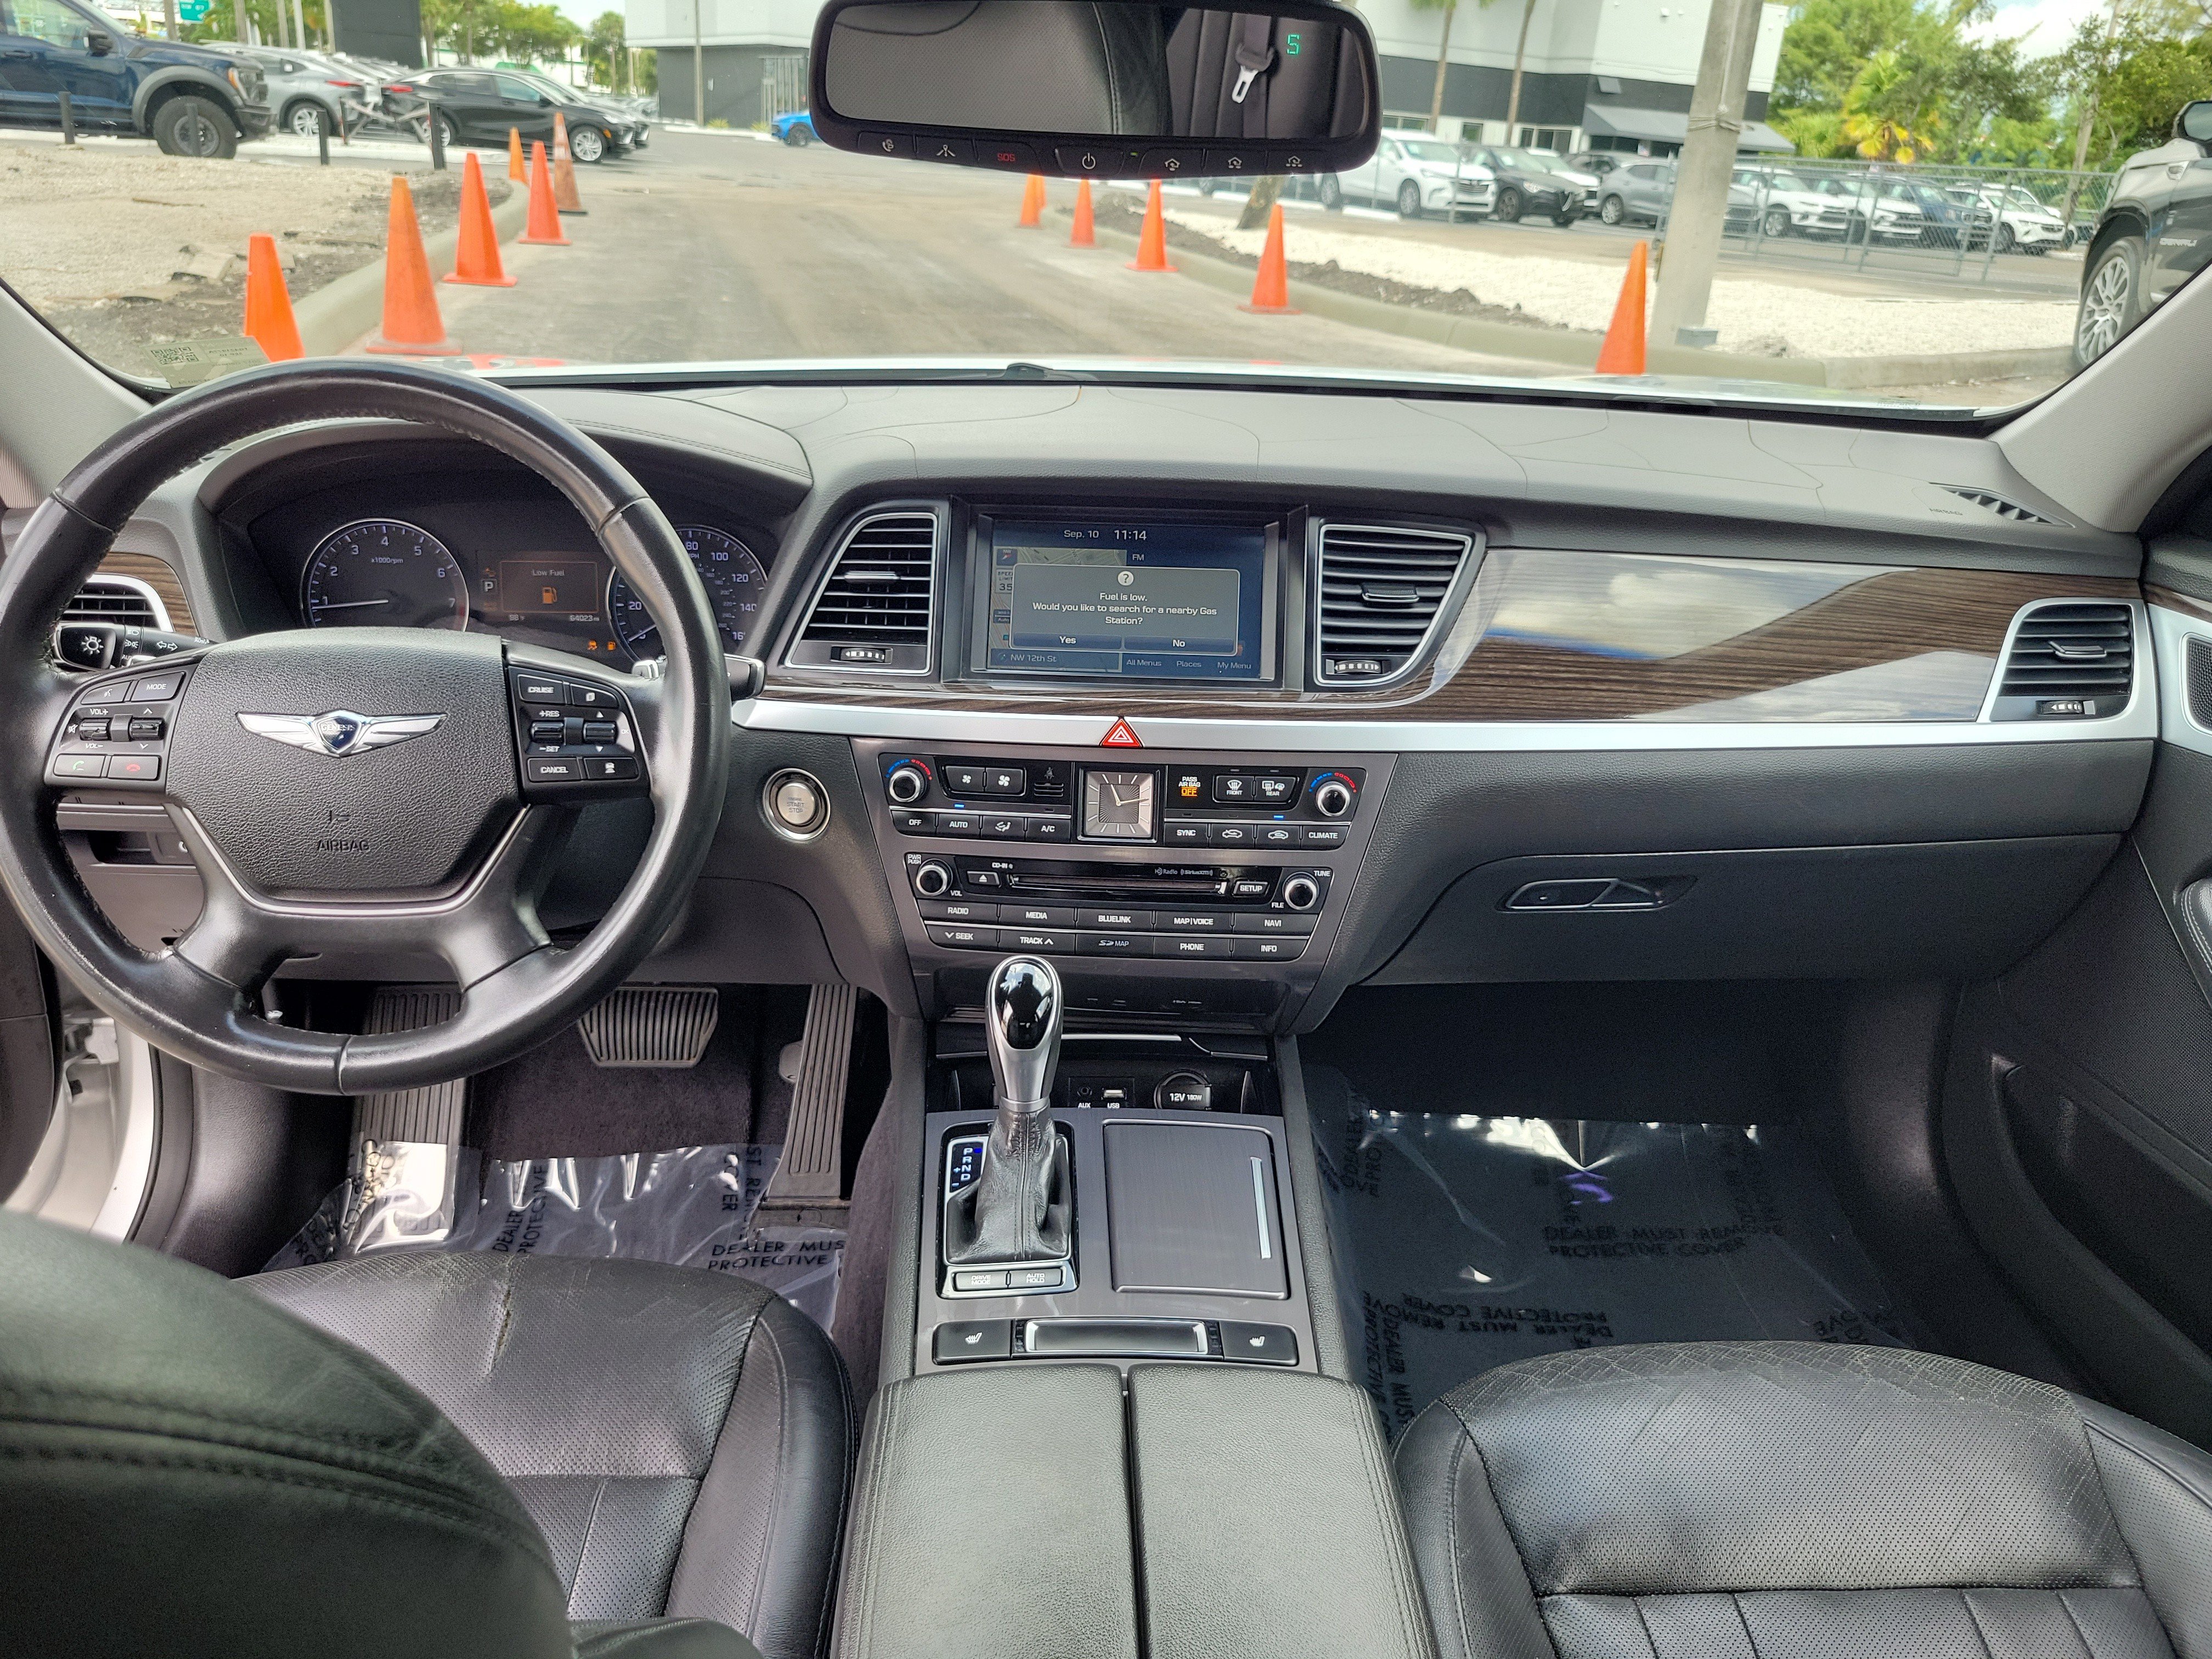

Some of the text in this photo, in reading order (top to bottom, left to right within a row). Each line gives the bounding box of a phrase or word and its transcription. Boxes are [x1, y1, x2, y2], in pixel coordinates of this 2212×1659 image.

[1286, 34, 1300, 54] S
[997, 153, 1015, 162] SOS
[1064, 530, 1085, 539] Sep.
[1114, 529, 1147, 541] 11:14
[381, 537, 389, 546] 4
[686, 541, 698, 551] 80
[351, 545, 359, 555] 3
[414, 545, 422, 556] 5
[711, 552, 729, 561] 100
[330, 566, 338, 577] 2
[438, 568, 445, 578] 6
[732, 574, 749, 583] 120
[484, 581, 493, 592] P
[999, 583, 1013, 591] 35
[1099, 592, 1148, 602] Fuel is low.
[448, 598, 456, 608] 7
[629, 602, 642, 611] 20
[1032, 602, 1060, 611] Would
[1062, 604, 1078, 612] you
[1080, 603, 1095, 612] like
[1109, 605, 1140, 613] search
[1142, 605, 1156, 614] for
[1166, 607, 1198, 616] nearby
[1200, 607, 1217, 616] Gas
[1105, 616, 1143, 625] Station?
[732, 631, 746, 640] 16
[1059, 635, 1077, 645] Yes
[1172, 639, 1186, 648] No
[1217, 662, 1229, 670] My
[540, 766, 569, 774] CANCEL
[1181, 788, 1198, 796] OFF
[909, 819, 922, 827] OFF
[949, 821, 968, 829] AUTO
[1041, 825, 1056, 833] A/C
[1308, 831, 1339, 839] CLIMATE
[317, 839, 371, 852] AIRBAG
[1239, 884, 1263, 893] SETUP
[947, 907, 969, 915] RADIO
[1025, 911, 1048, 920] MEDIA
[1098, 915, 1131, 924] BLUELINK
[1263, 918, 1282, 927] NAVI
[955, 933, 974, 941] SEEK
[1019, 936, 1043, 945] TRACK
[1180, 942, 1205, 951] PHONE
[1260, 944, 1278, 953] INFO
[1170, 1093, 1185, 1102] 12V
[963, 1147, 973, 1155] P
[961, 1164, 972, 1172] N
[961, 1173, 971, 1182] D
[492, 1209, 525, 1253] DEALER
[712, 1241, 785, 1257] DEALER
[708, 1253, 828, 1272] PROTECTIVE
